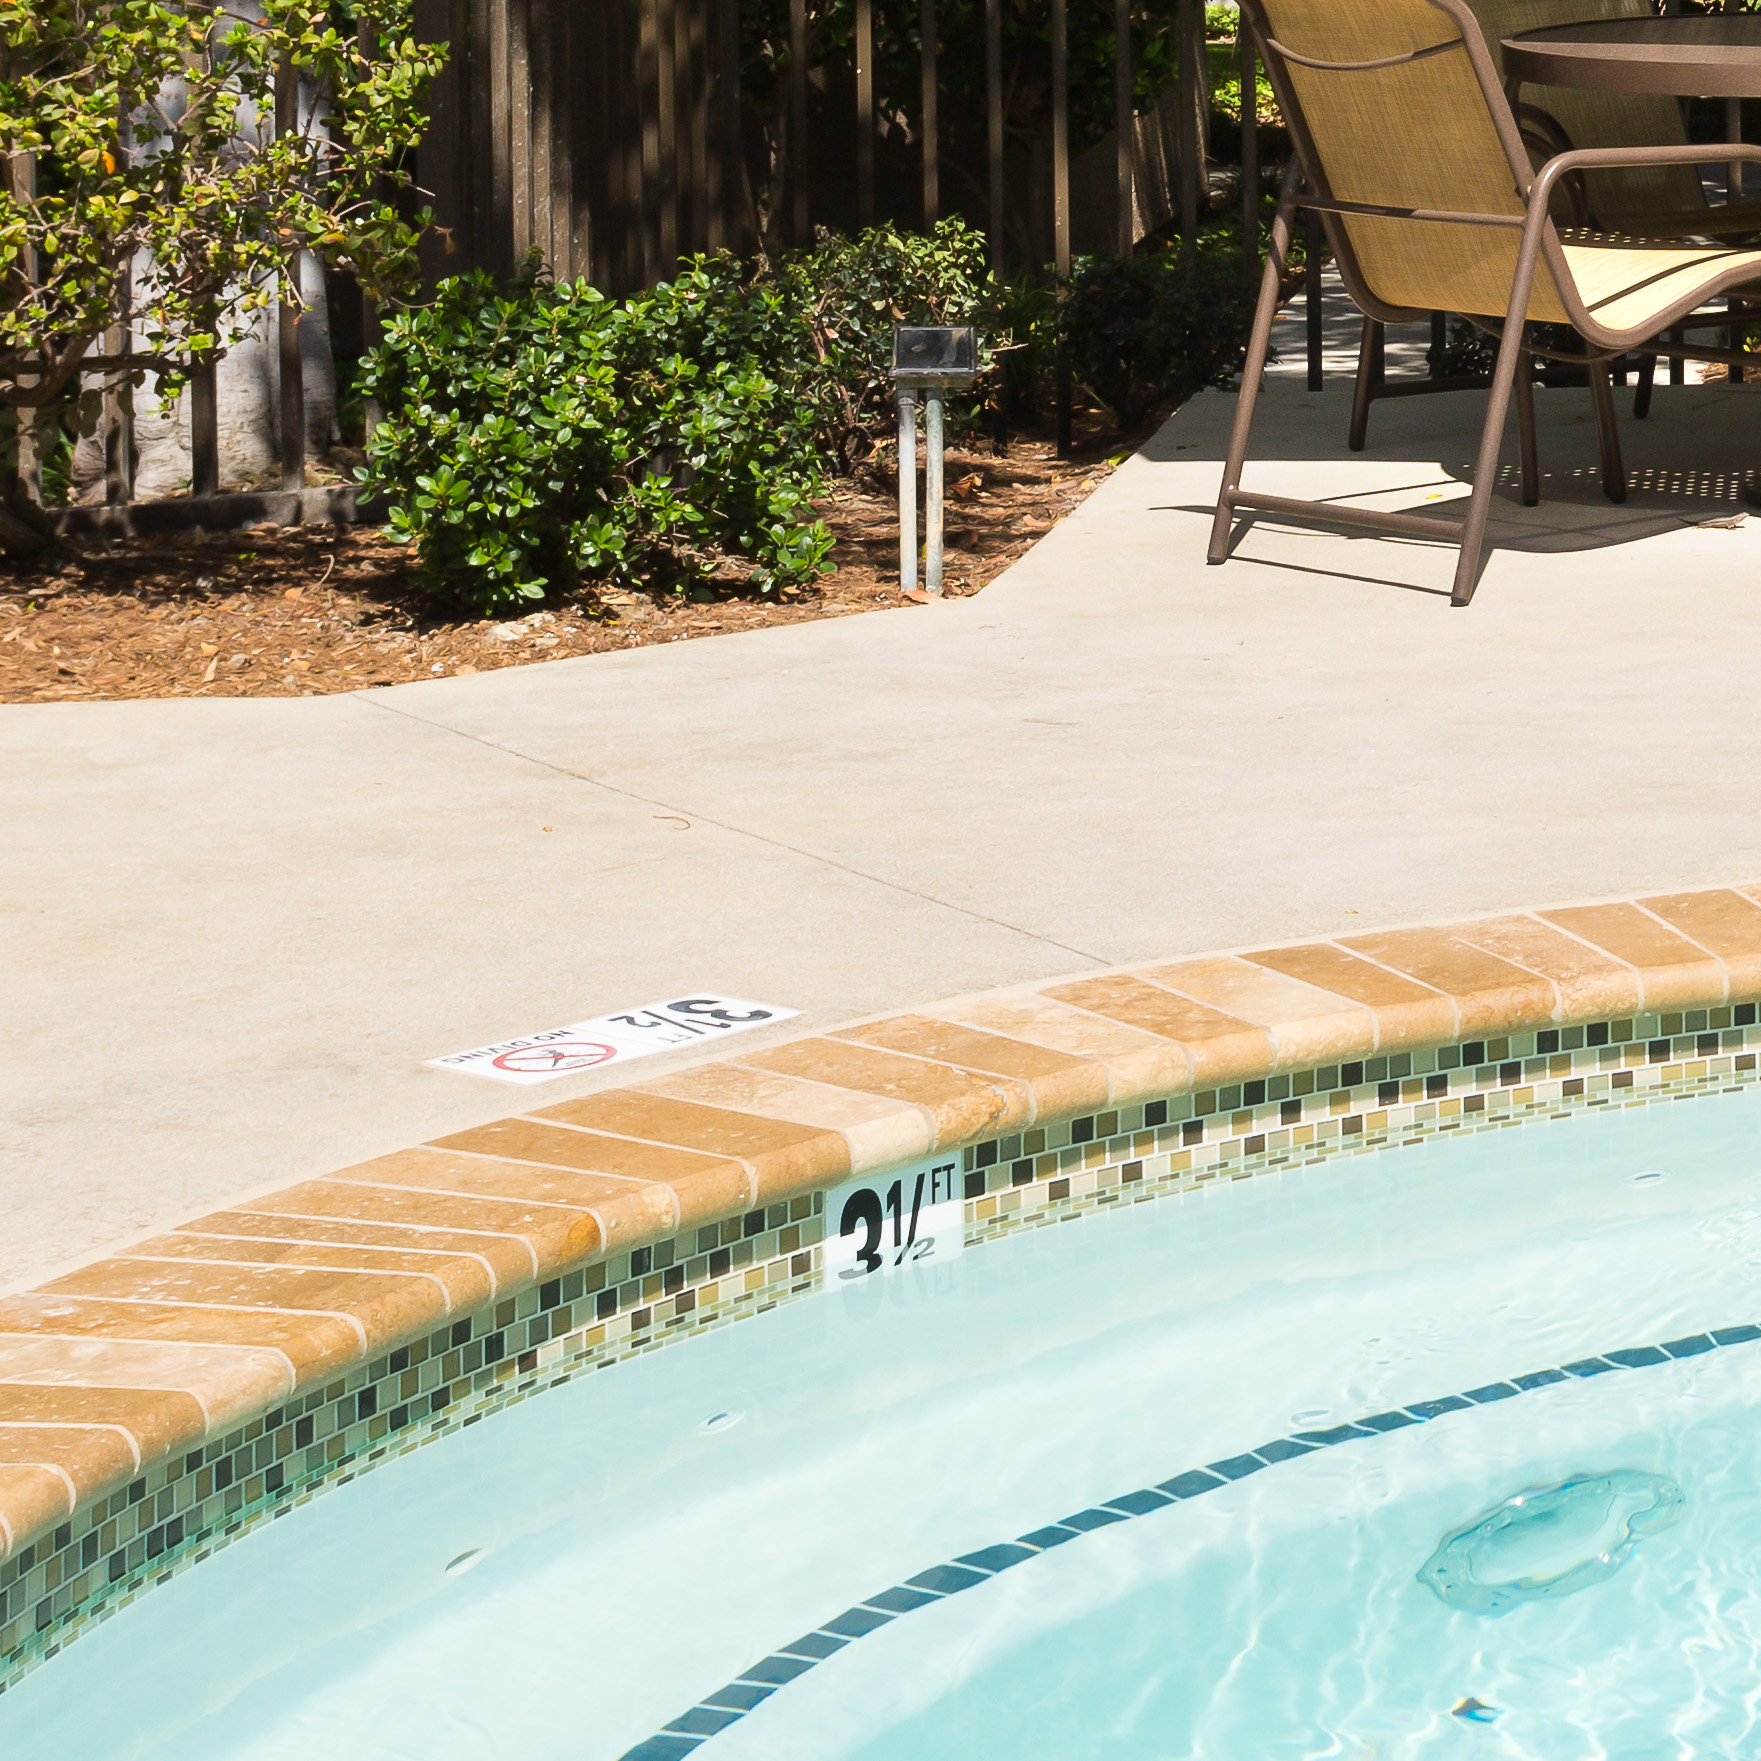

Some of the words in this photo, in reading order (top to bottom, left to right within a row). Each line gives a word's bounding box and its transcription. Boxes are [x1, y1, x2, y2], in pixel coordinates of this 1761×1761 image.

[533, 1029, 575, 1042] NO
[441, 1040, 532, 1065] DIVING
[931, 1162, 956, 1205] FT
